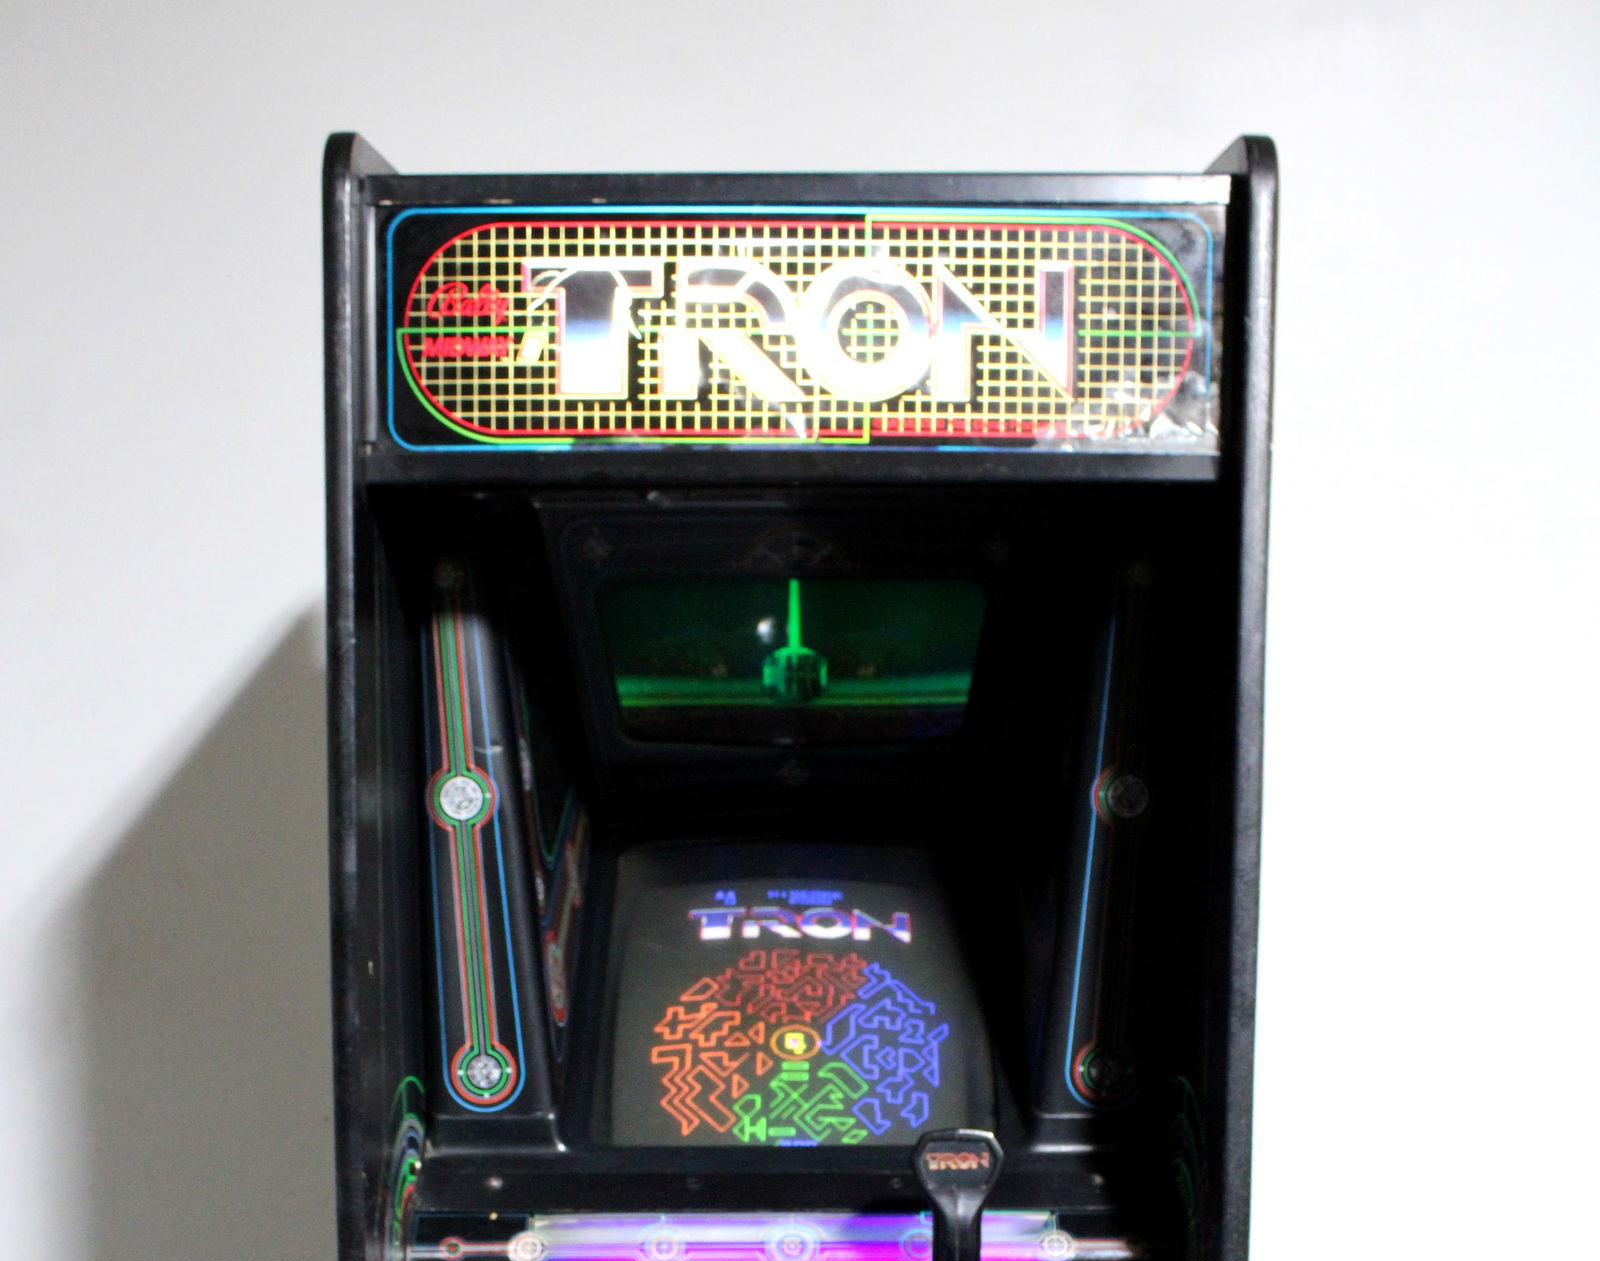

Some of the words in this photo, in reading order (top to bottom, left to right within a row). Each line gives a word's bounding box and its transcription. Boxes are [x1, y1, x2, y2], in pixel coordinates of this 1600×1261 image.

[522, 255, 1076, 402] TRON
[688, 905, 912, 943] TRON
[926, 1151, 990, 1171] TRON
